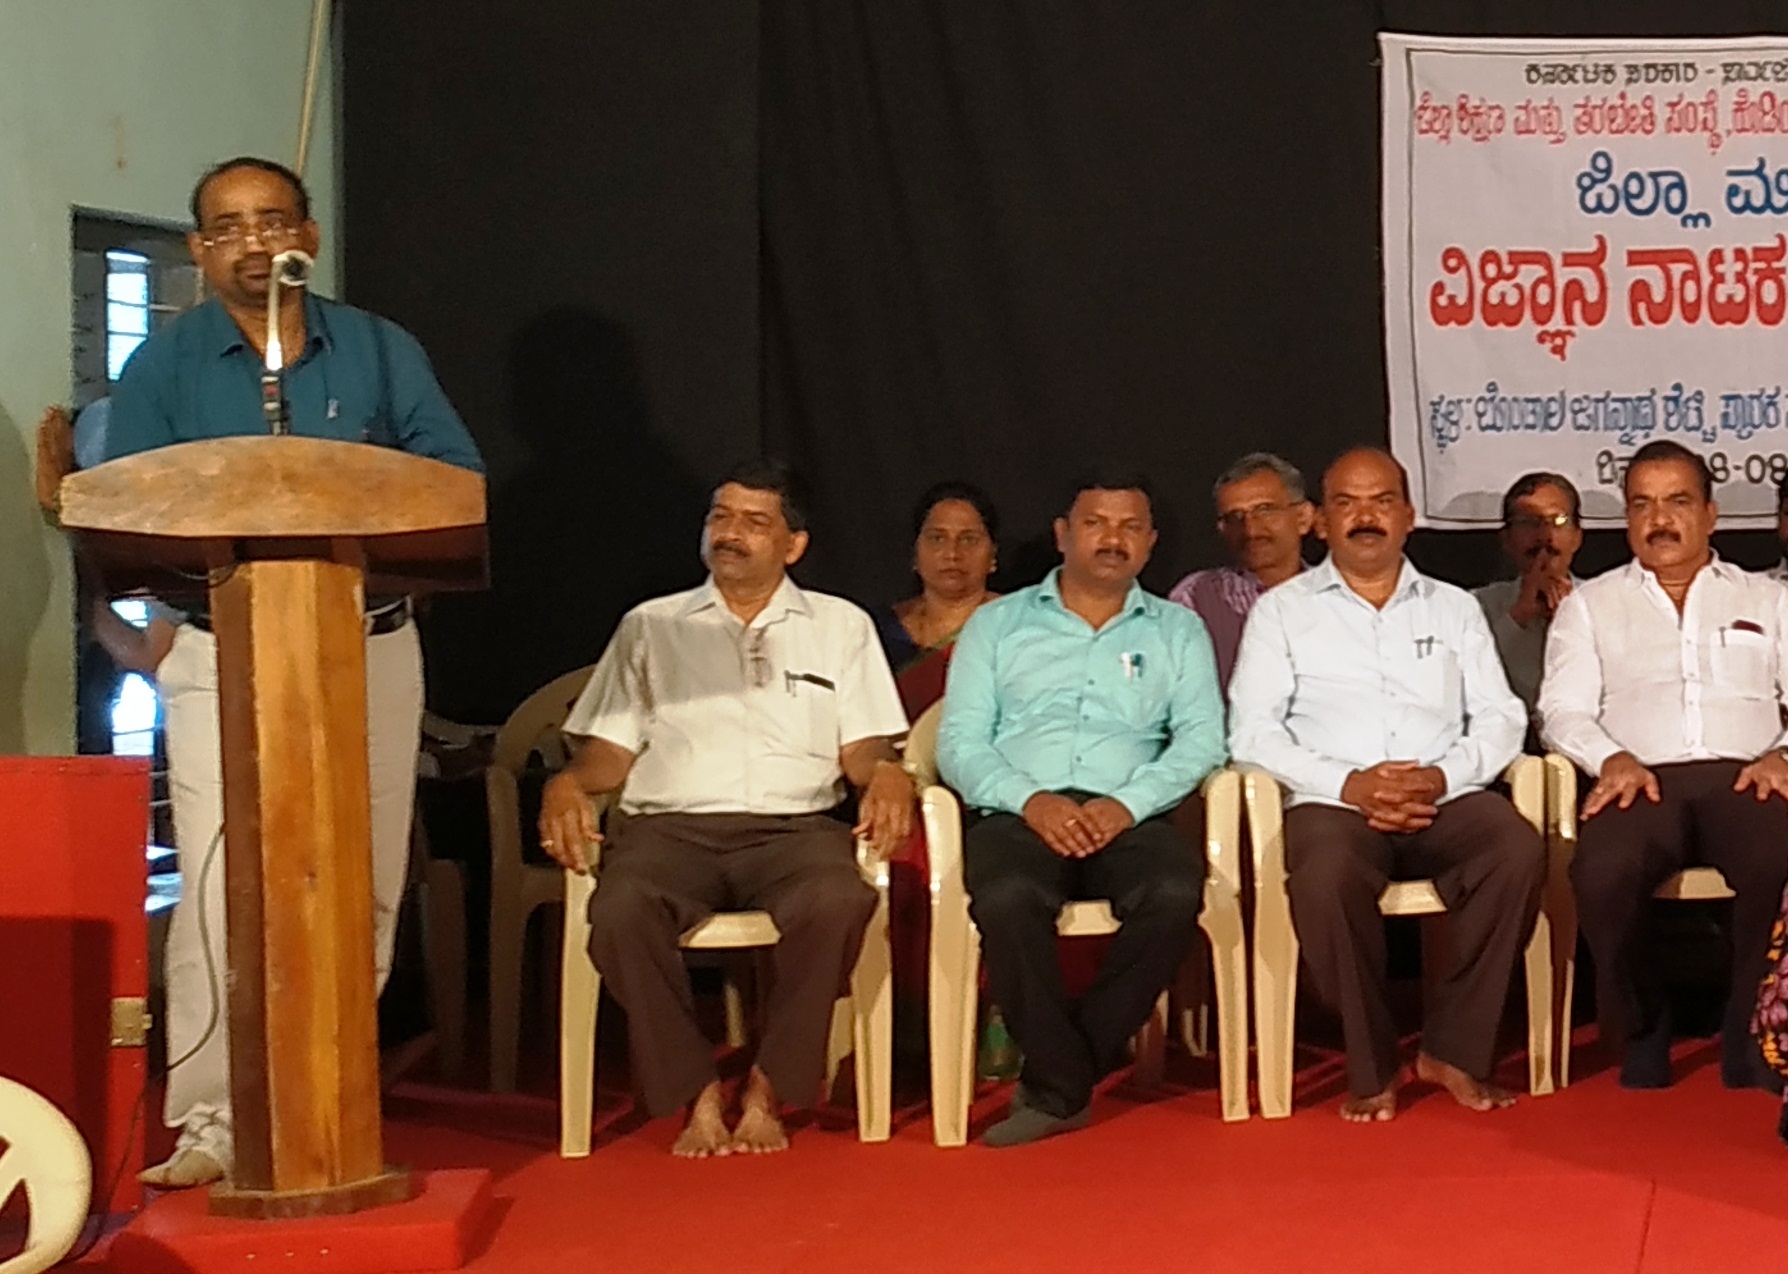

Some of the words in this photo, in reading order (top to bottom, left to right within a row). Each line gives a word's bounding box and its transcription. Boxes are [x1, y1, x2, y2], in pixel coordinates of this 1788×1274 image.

[1576, 151, 1711, 228] ಜಿಲ್ಲಾ
[1430, 234, 1608, 361] ವಿಜ್ಞಾನ
[1627, 233, 1787, 328] ನಾಟಕ
